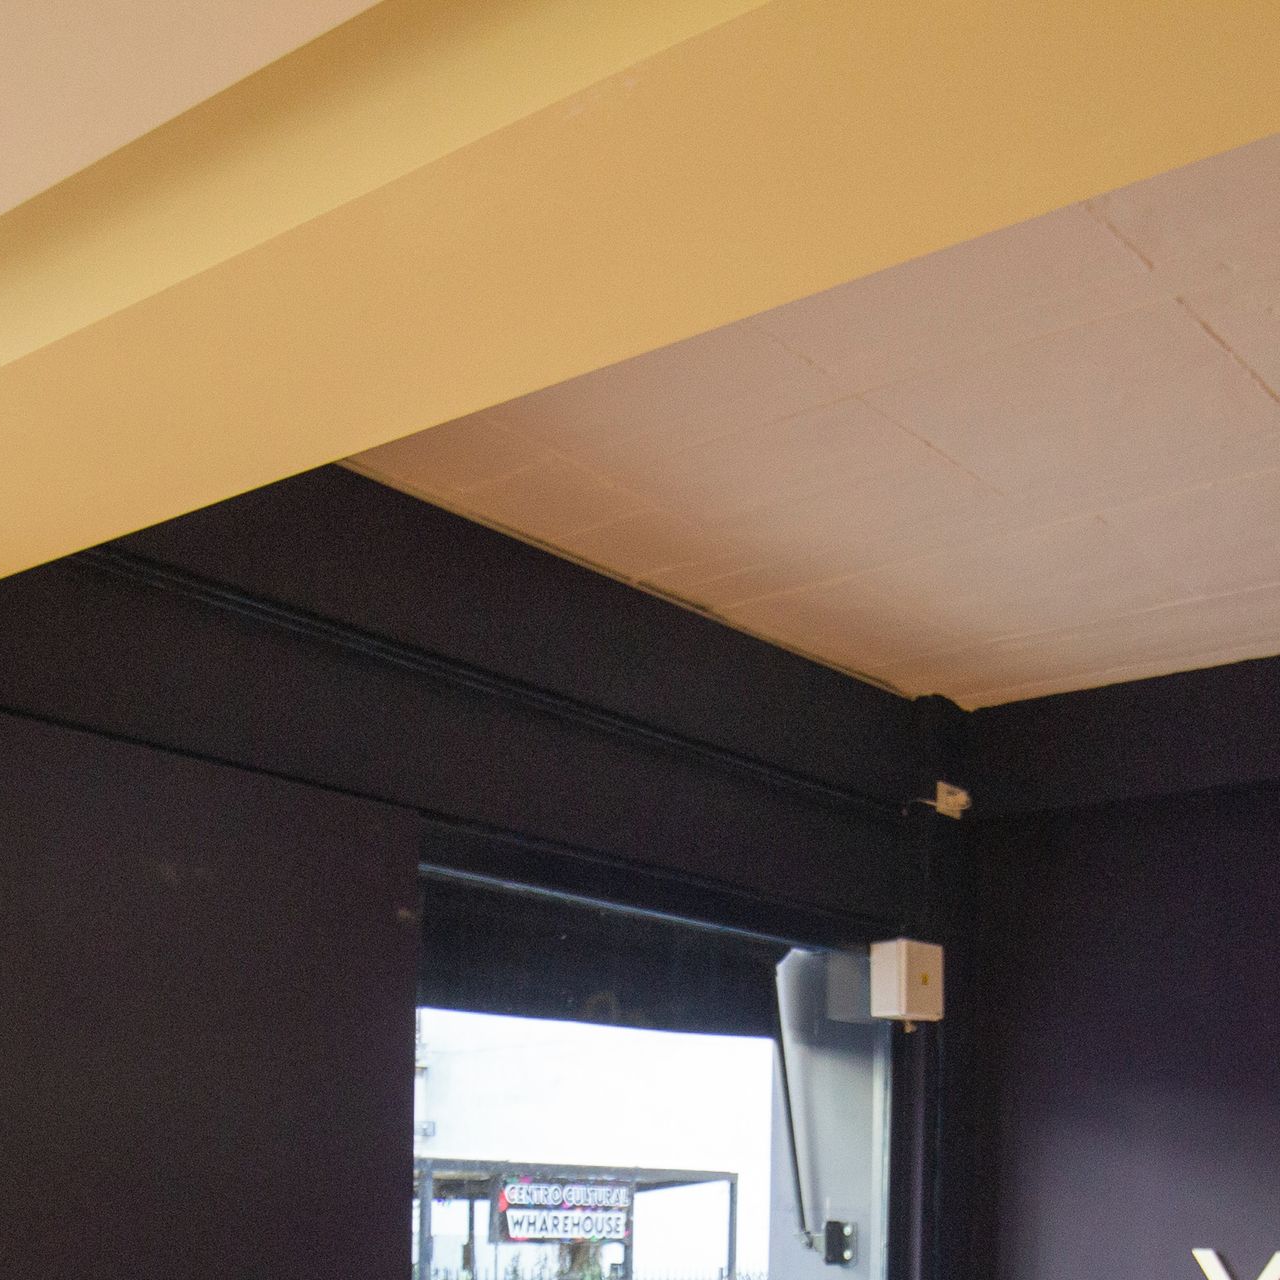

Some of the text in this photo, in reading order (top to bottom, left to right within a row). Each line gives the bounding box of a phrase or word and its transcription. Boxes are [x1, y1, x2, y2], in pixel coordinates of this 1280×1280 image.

[506, 1184, 629, 1207] CENTRO CULTURAL
[511, 1213, 623, 1235] WHAREHOUSE
